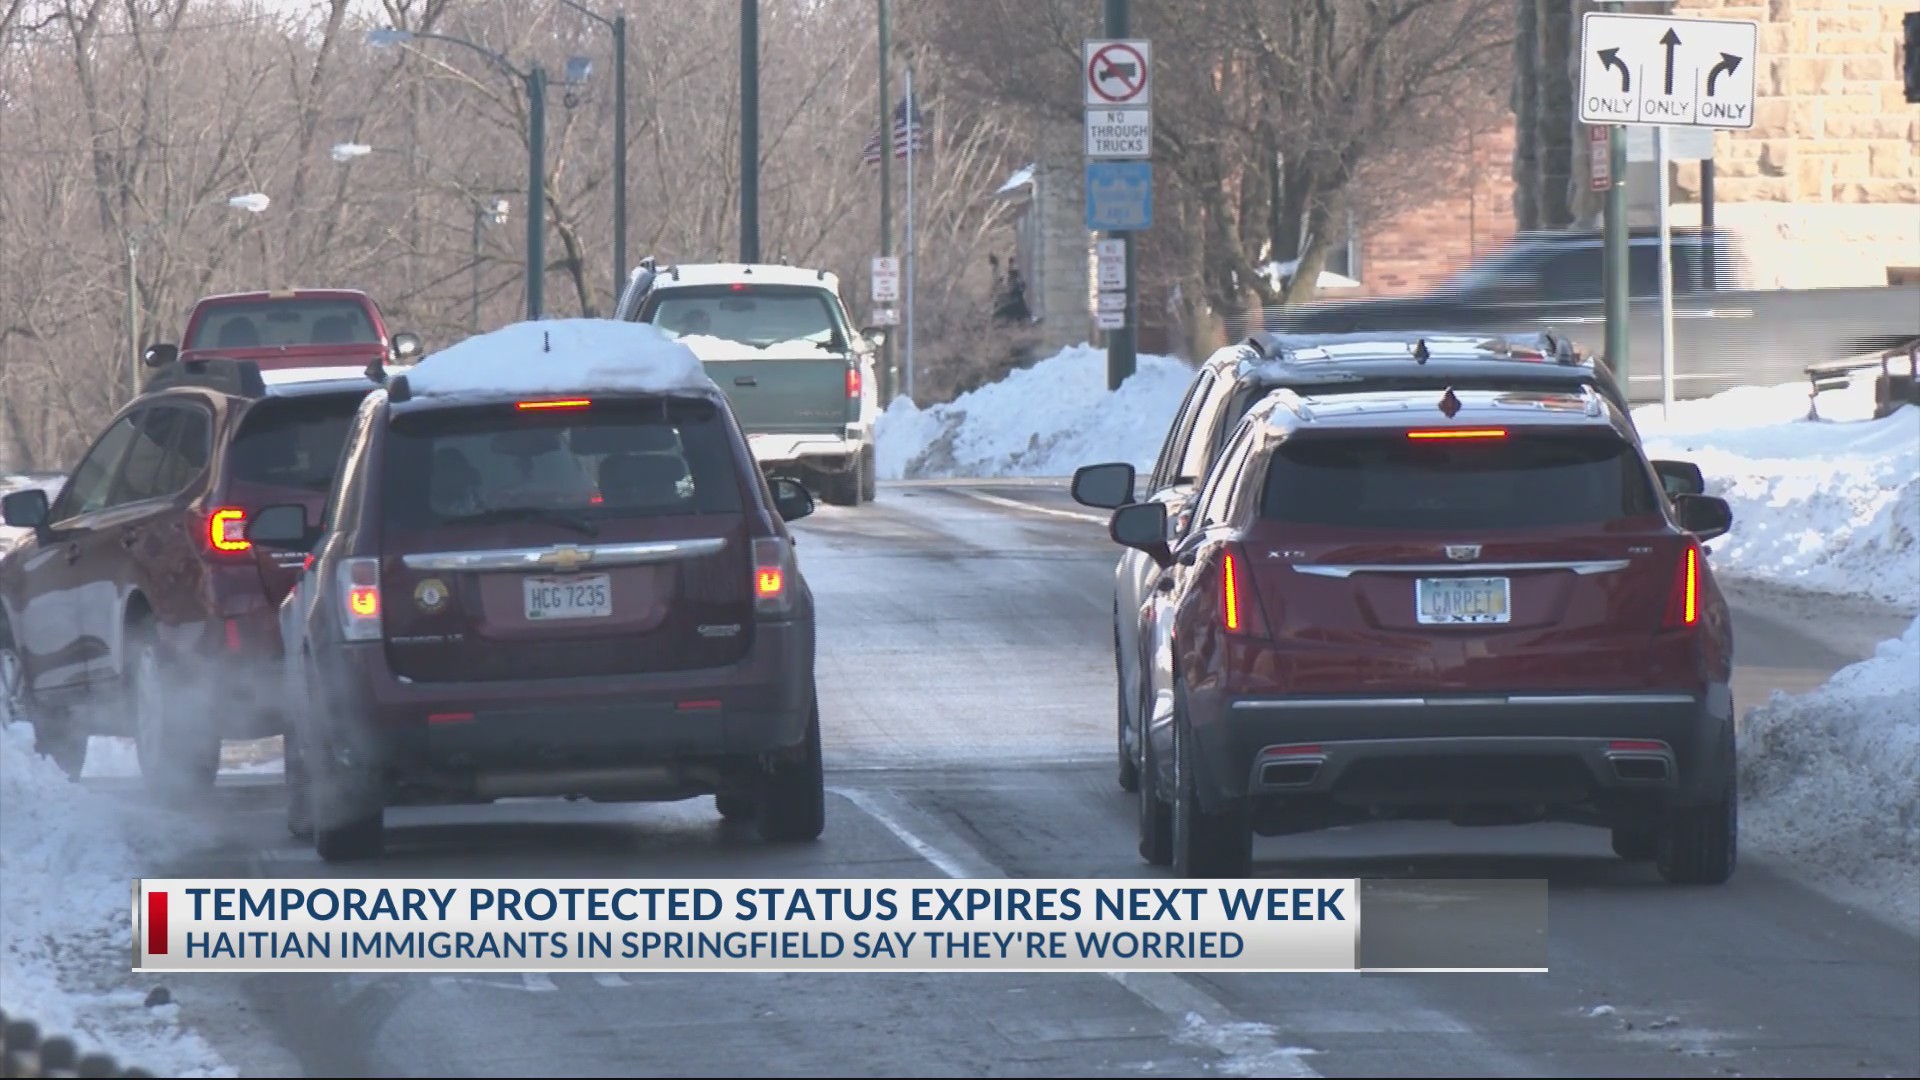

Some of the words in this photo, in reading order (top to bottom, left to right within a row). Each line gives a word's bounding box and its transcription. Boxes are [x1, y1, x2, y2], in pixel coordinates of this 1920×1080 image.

[1588, 96, 1633, 114] ONLY
[1644, 99, 1690, 116] ONLY
[1701, 102, 1747, 119] ONLY
[1107, 111, 1125, 124] NO
[1091, 125, 1148, 138] THROUGH
[1096, 139, 1143, 152] TRUCKS
[531, 586, 561, 609] HCG
[565, 584, 606, 608] 7235
[1432, 590, 1492, 614] CARPET
